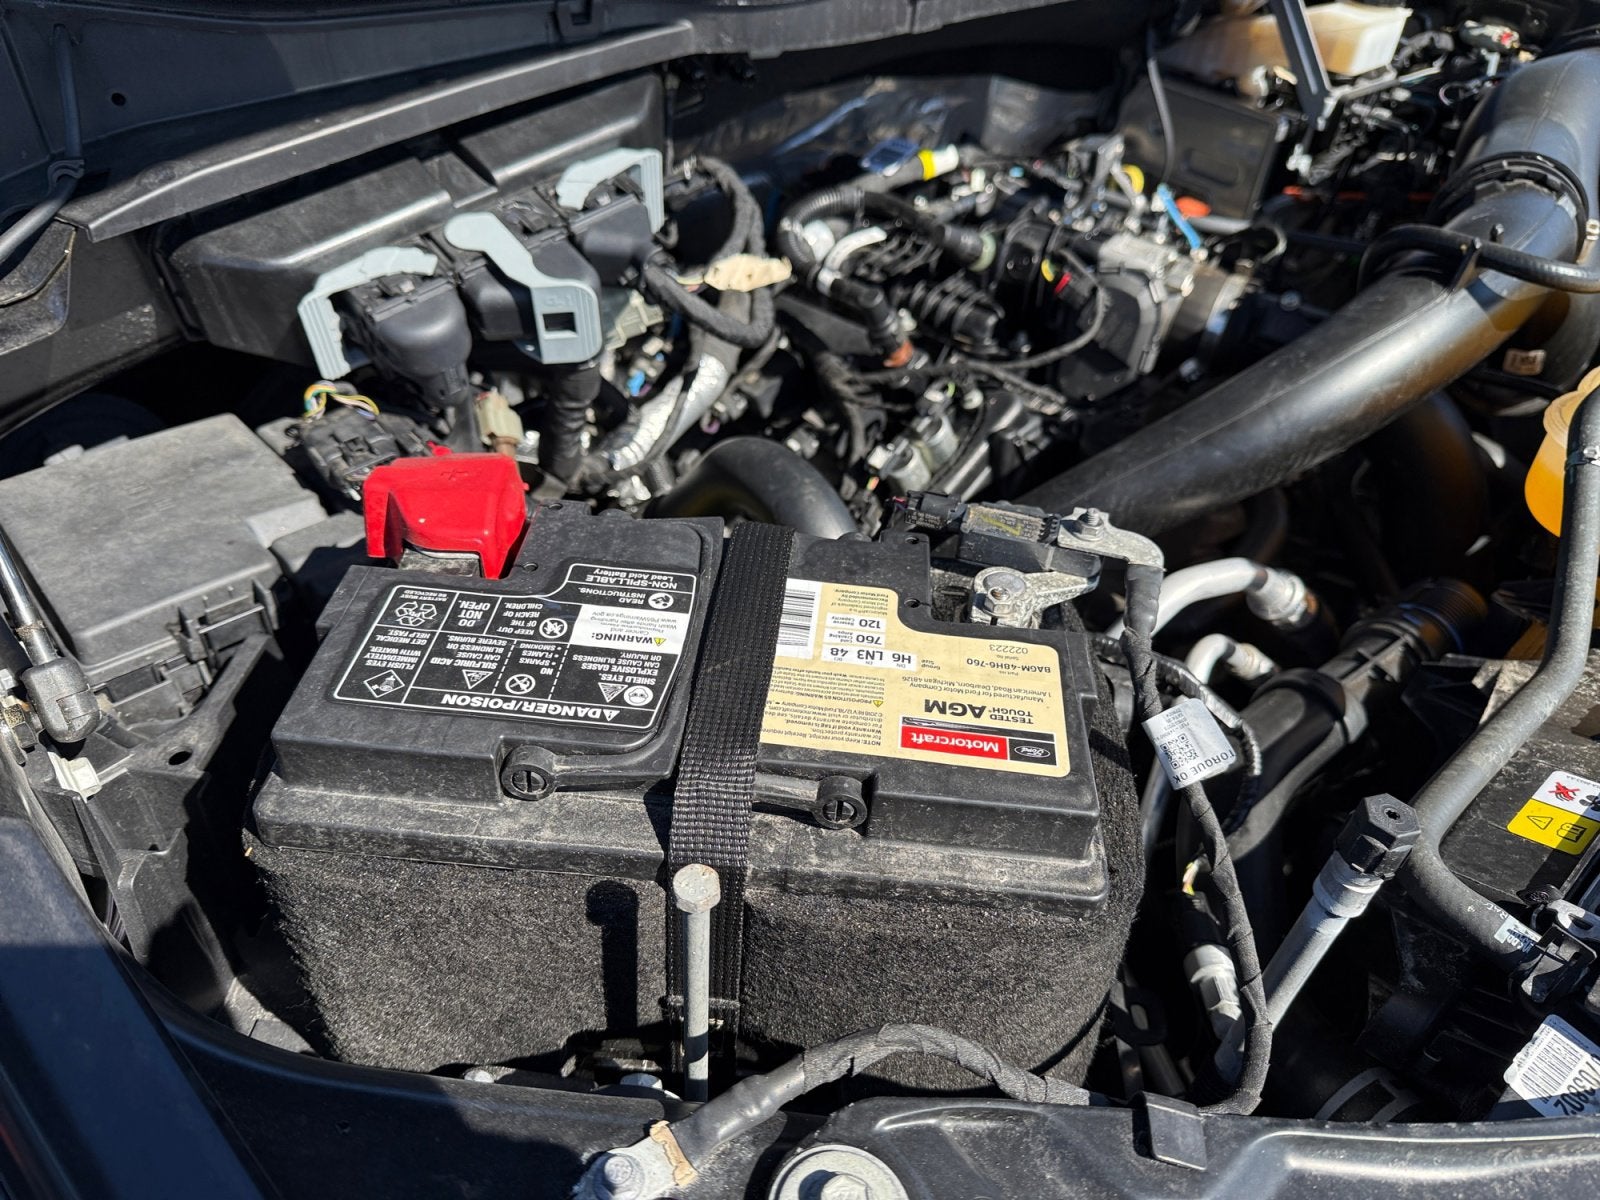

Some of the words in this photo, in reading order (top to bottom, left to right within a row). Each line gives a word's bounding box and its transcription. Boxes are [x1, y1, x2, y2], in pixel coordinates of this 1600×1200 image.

[592, 569, 627, 577] Battery
[584, 575, 678, 589] NON-SPILLABLE
[577, 588, 647, 598] INSTRUCTIONS.
[455, 600, 492, 610] OPEN.
[502, 601, 544, 611] CHILDREN.
[458, 610, 484, 619] NOT
[515, 610, 541, 618] REACH
[458, 619, 476, 627] DO
[859, 619, 881, 629] 120
[374, 635, 411, 643] MEDICAL
[590, 633, 654, 644] WARNING:
[856, 635, 882, 645] 760
[368, 646, 400, 654] WATER.
[459, 644, 504, 653] BLINDNESS
[520, 643, 556, 651] SMOKING
[989, 644, 1028, 654] 022223
[522, 650, 554, 658] FLAMES
[620, 652, 649, 660] INJURY.
[830, 648, 848, 657] 48
[857, 649, 883, 661] LN3
[363, 653, 419, 663] IMMEDIATELY
[430, 657, 454, 665] ACID
[519, 658, 551, 666] SPARKS
[572, 654, 616, 663] BLINDNESS
[892, 653, 911, 664] H6
[453, 659, 498, 669] SULFURIC
[967, 658, 1050, 673] BAGM-48H6-760
[611, 666, 658, 675] EXPLOSIVE
[624, 676, 656, 685] SHIELD
[924, 677, 954, 686] Michigan
[910, 682, 942, 691] Company
[957, 681, 990, 690] Dearborn,
[992, 685, 1012, 693] Road,
[1014, 688, 1046, 696] American
[833, 696, 872, 704] PROPOSITION
[994, 692, 1043, 702] Manufactured
[441, 694, 602, 719] DANGER/POISON
[782, 700, 808, 708] Company
[925, 700, 986, 719] AGM
[785, 718, 814, 726] removed.
[813, 715, 840, 723] warranty
[842, 718, 871, 726] complete
[990, 714, 1033, 724] TESTED
[784, 729, 807, 737] Receipt
[845, 730, 871, 738] warranty
[853, 726, 881, 734] Warranty
[911, 733, 999, 753] Motorcraft
[1021, 746, 1044, 757] Ford
[1190, 749, 1236, 776] TORQUE
[1172, 772, 1188, 784] OK
